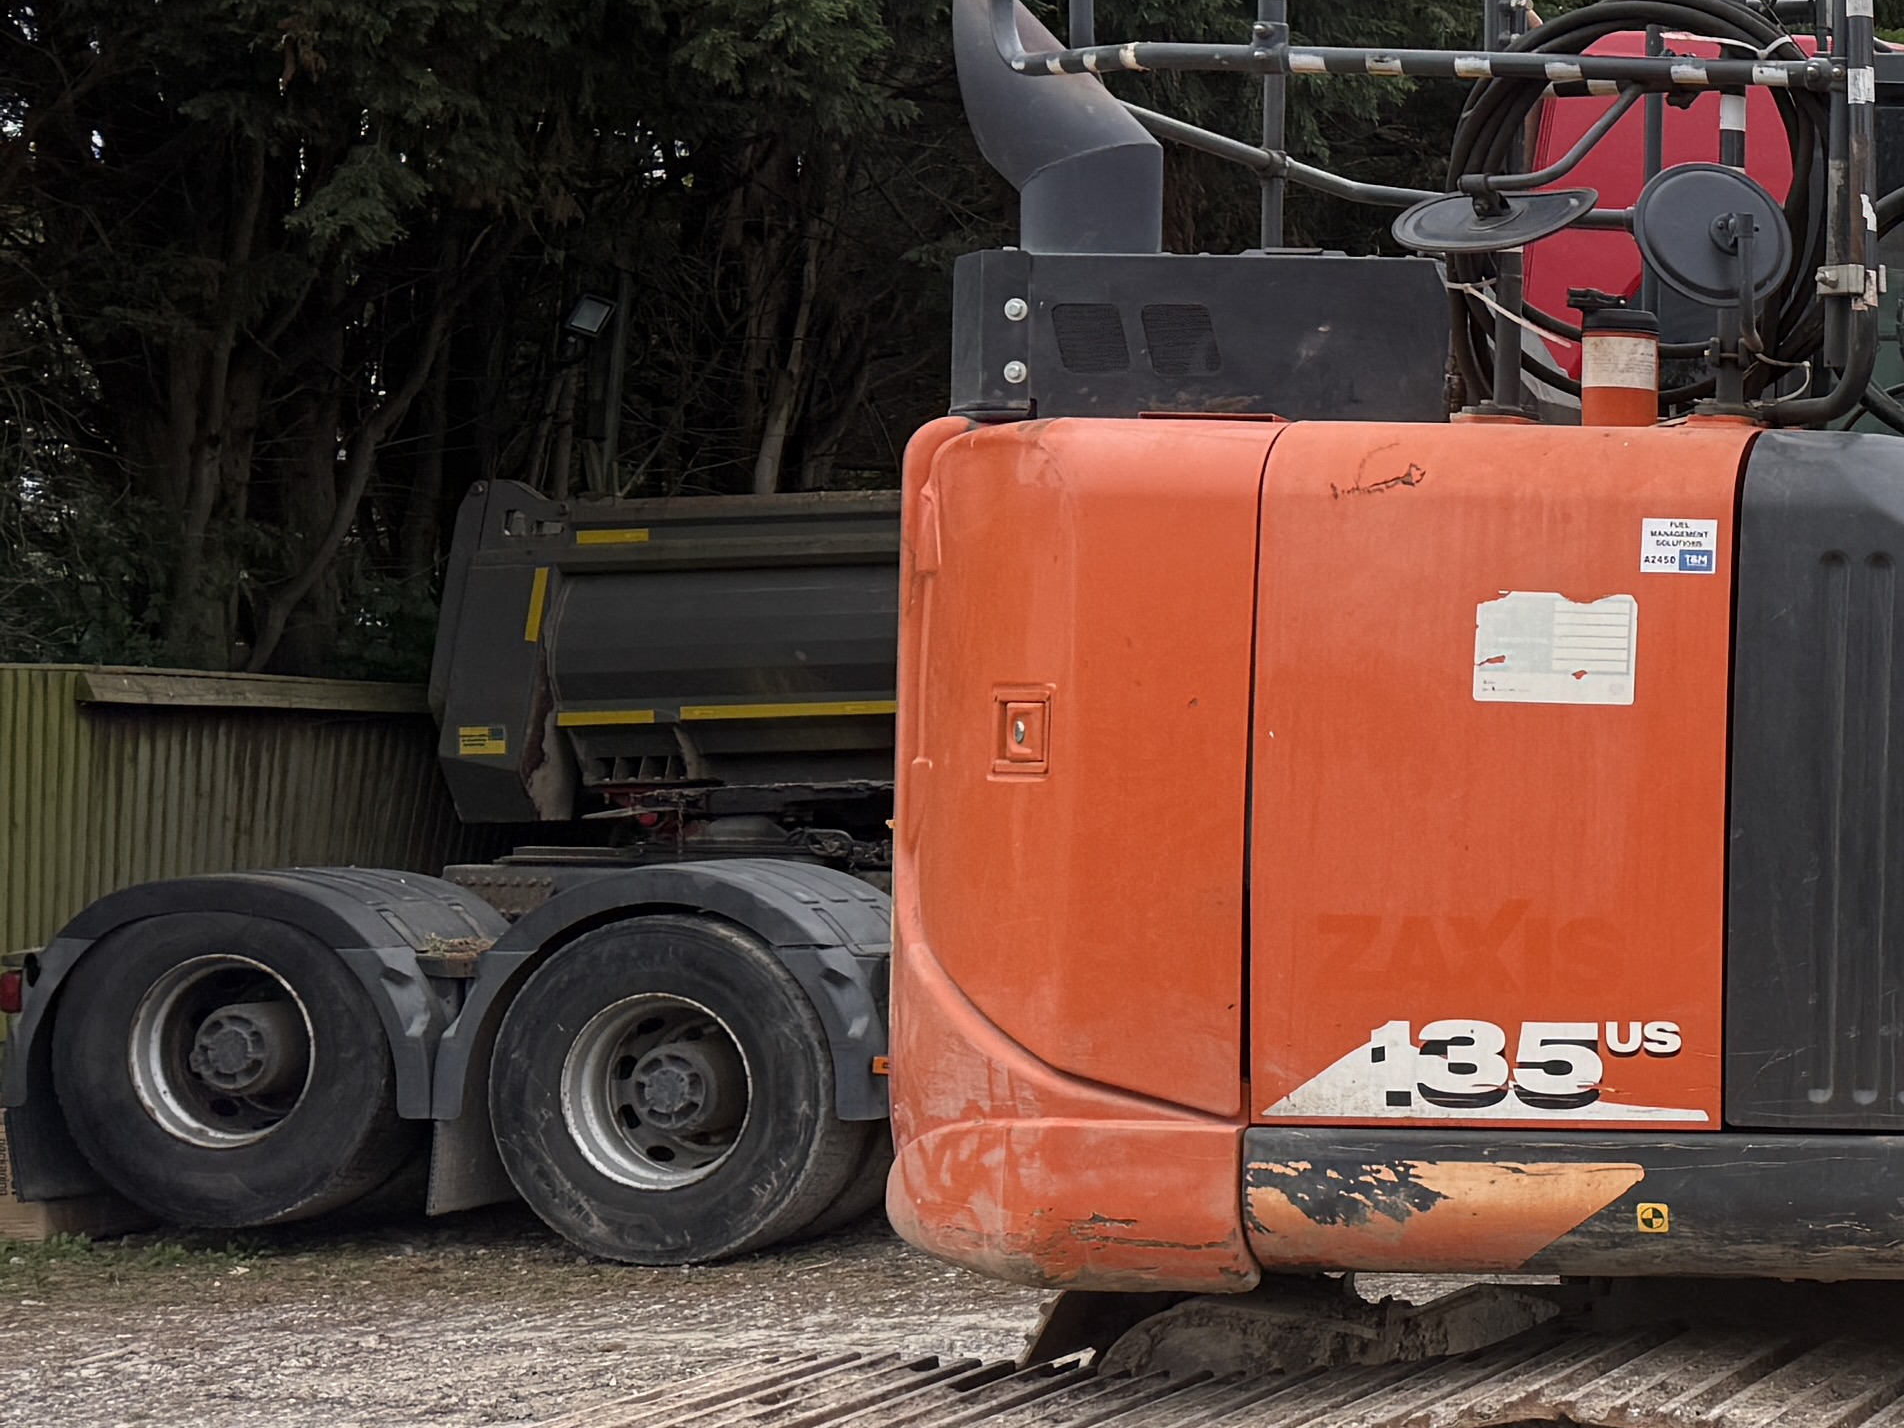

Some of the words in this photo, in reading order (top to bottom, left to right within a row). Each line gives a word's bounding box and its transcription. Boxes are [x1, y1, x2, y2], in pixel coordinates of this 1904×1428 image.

[1650, 530, 1708, 539] MANAGEMENT
[1656, 539, 1703, 547] SOLUTIONS
[1605, 1018, 1683, 1057] US
